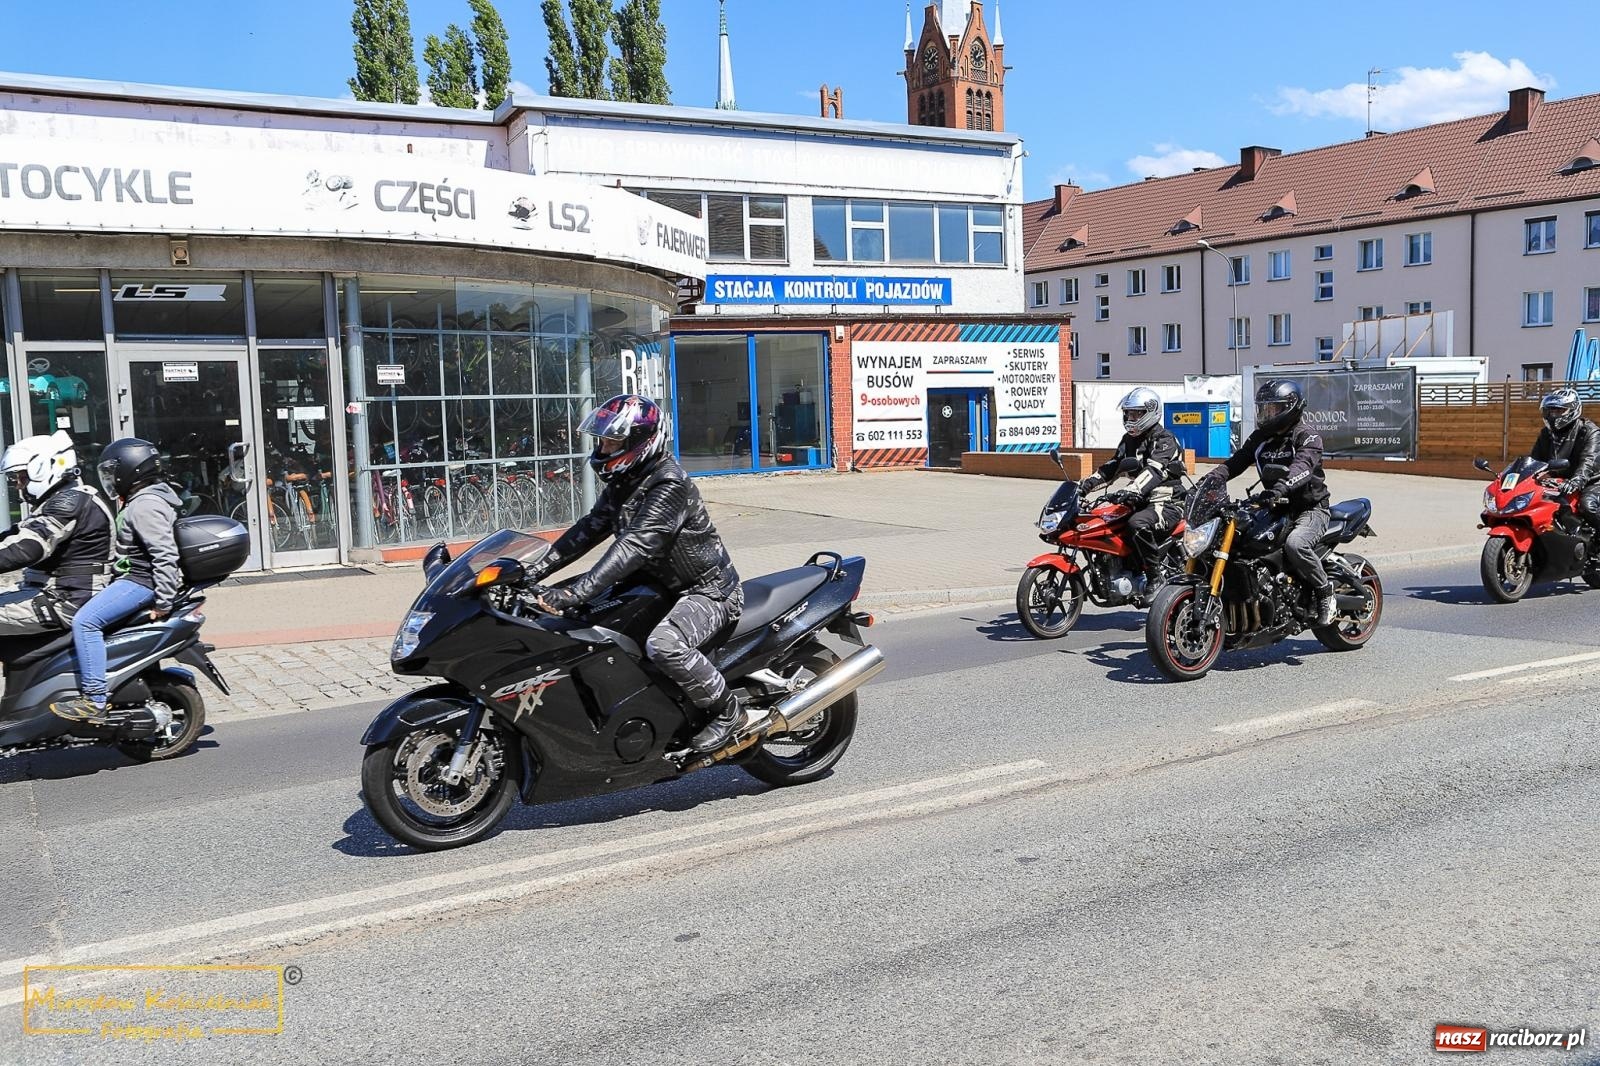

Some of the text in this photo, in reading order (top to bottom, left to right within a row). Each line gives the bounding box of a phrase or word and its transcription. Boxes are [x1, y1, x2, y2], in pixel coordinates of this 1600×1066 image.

[0, 162, 194, 204] TOCYKLE
[374, 177, 476, 222] CZĘŚCI
[548, 200, 591, 233] LS2
[715, 280, 944, 301] STACJA KONTROLI POJAZDÓW
[1012, 348, 1045, 359] SERWIS
[857, 355, 922, 369] WYNAJEM
[932, 355, 988, 366] ZAPRASZAMY
[1009, 361, 1049, 371] SKUTERY
[866, 371, 914, 389] BUSÓW
[1001, 373, 1056, 384] MOTOROWERY
[1010, 386, 1048, 397] ROWERY
[1353, 382, 1404, 392] ZAPRASZAMY!
[860, 393, 921, 408] 9-osobowych
[1013, 399, 1046, 411] QUADY
[868, 429, 922, 441] 602 111 553
[1008, 425, 1057, 437] 884 049 292
